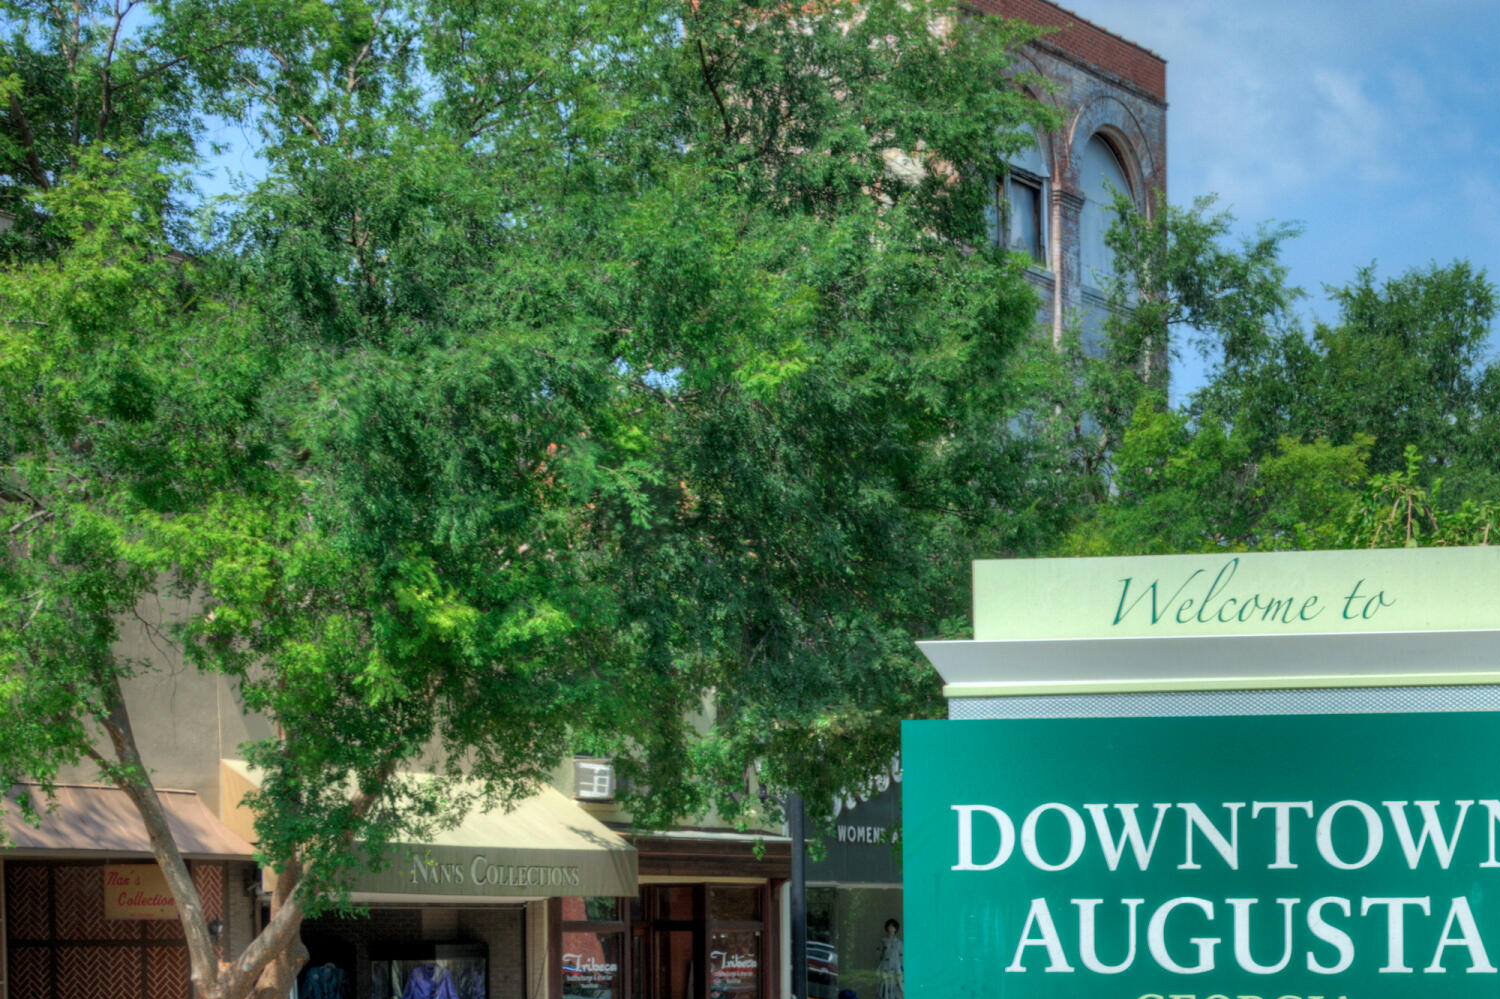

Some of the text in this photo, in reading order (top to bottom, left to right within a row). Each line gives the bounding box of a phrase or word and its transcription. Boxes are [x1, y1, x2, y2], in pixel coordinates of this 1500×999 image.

[1112, 557, 1396, 626] Welcome to
[411, 854, 580, 887] NAN'S COLLECTIONS
[1004, 895, 1498, 975] AUGUSTA
